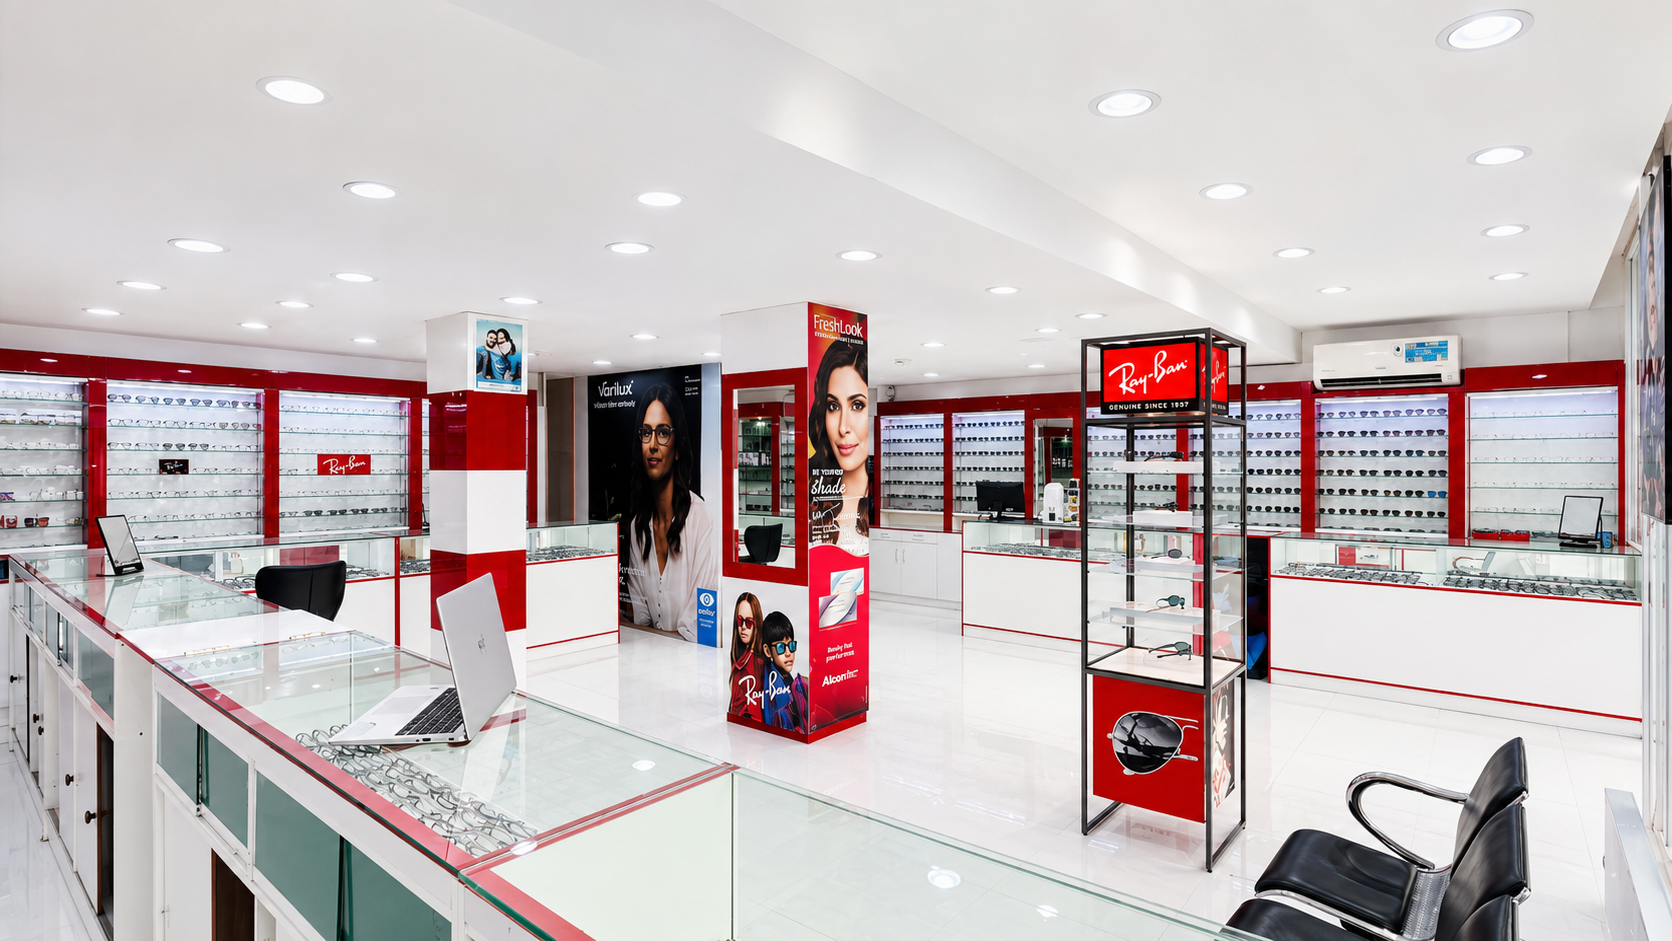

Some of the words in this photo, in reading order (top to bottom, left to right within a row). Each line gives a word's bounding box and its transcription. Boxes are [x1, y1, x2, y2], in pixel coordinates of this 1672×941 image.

[813, 314, 863, 338] FreshLook
[1108, 350, 1188, 395] Ray-Ban
[598, 380, 634, 397] Varilux
[322, 455, 366, 474] Ray-Ban
